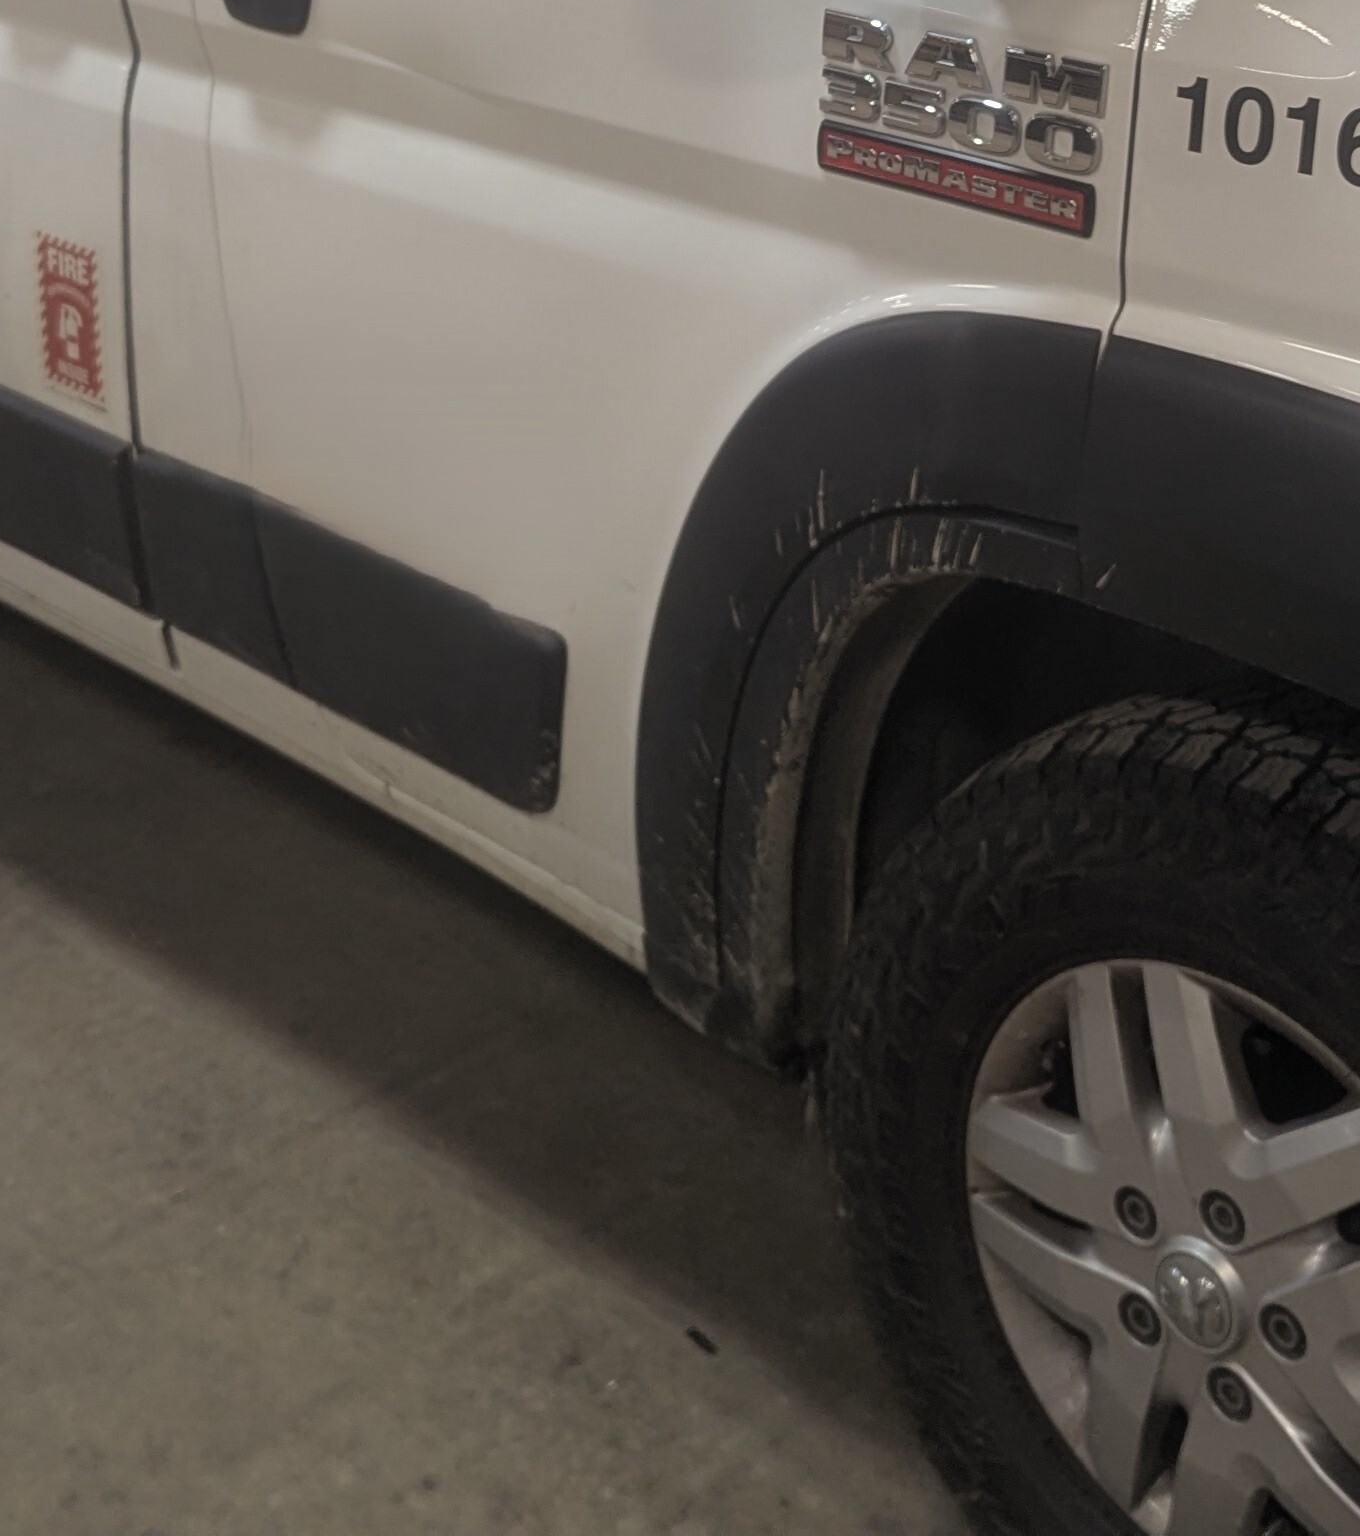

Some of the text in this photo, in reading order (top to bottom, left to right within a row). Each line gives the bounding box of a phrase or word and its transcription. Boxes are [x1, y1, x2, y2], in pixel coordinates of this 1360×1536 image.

[821, 9, 1110, 119] RAM
[818, 64, 1103, 176] 3500
[826, 134, 1078, 221] PROMASTER
[46, 245, 91, 287] FIRE
